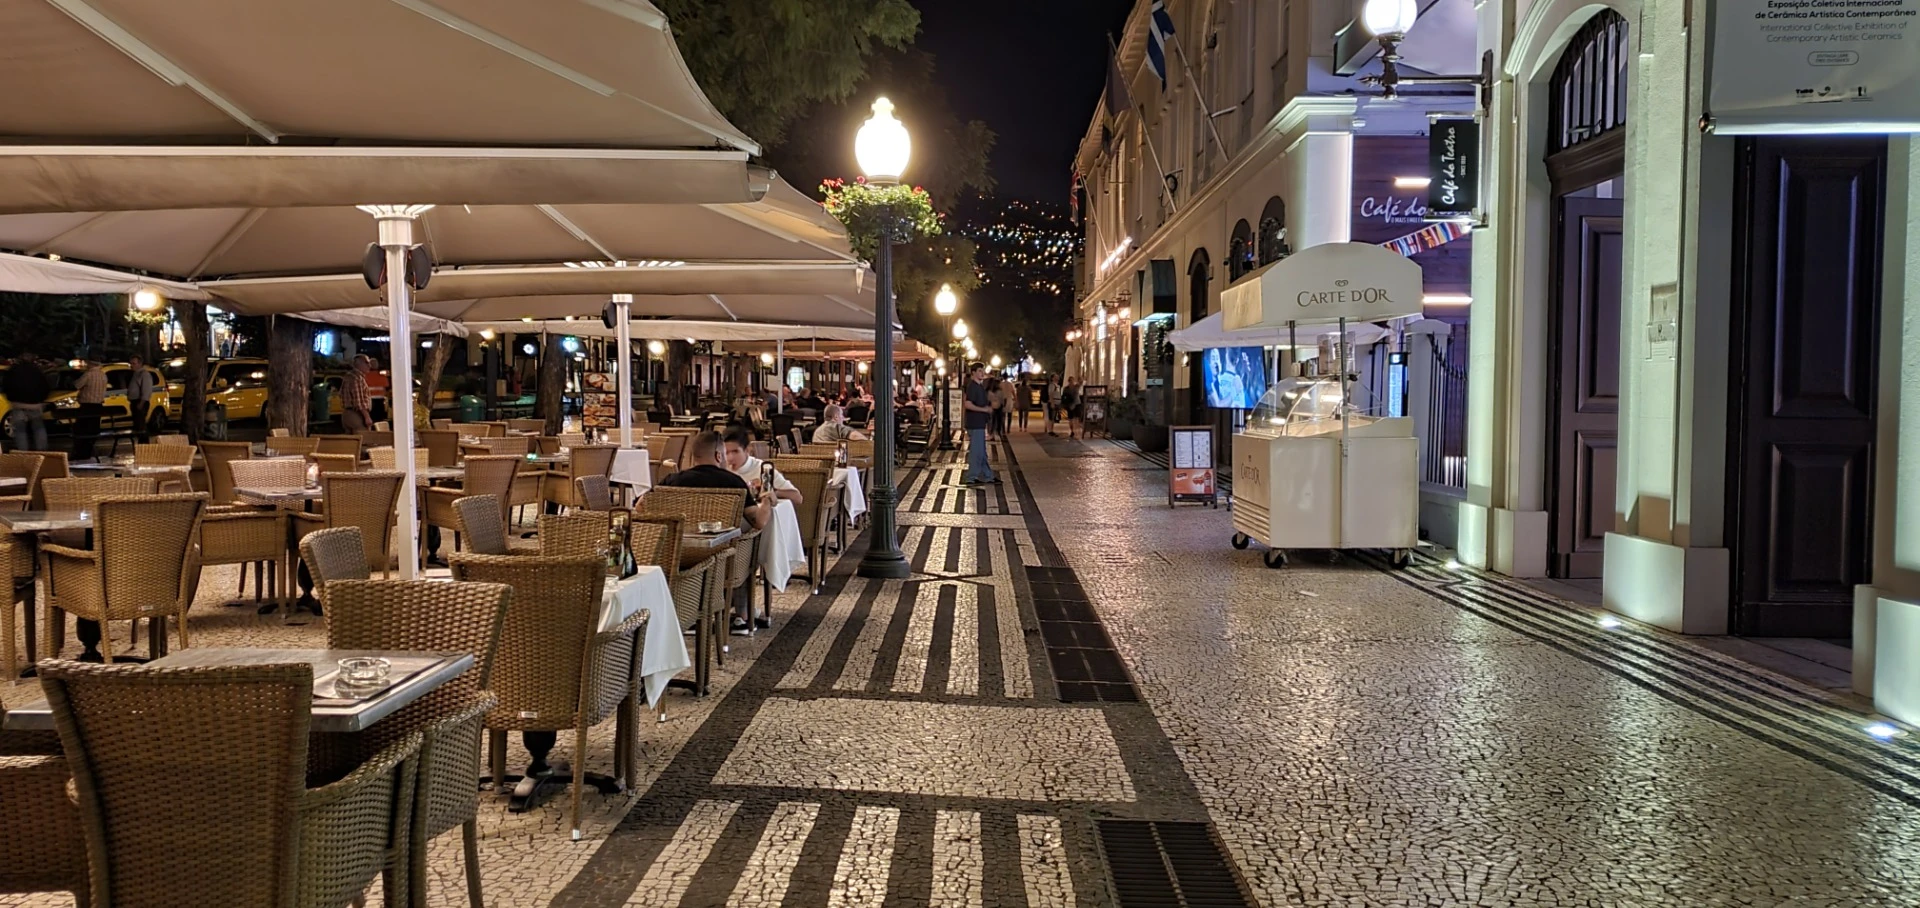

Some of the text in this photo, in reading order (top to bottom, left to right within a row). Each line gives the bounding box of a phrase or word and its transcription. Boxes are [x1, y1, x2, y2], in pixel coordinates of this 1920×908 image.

[1768, 0, 1810, 9] Exposição
[1755, 11, 1766, 19] de
[1760, 21, 1908, 32] International Collective Exhibition of
[1766, 33, 1903, 43] Contemporary Artistic Ceramics
[1442, 126, 1459, 205] Café do Teatro
[1361, 196, 1427, 223] Café do
[1297, 287, 1395, 307] CARTE D'OR
